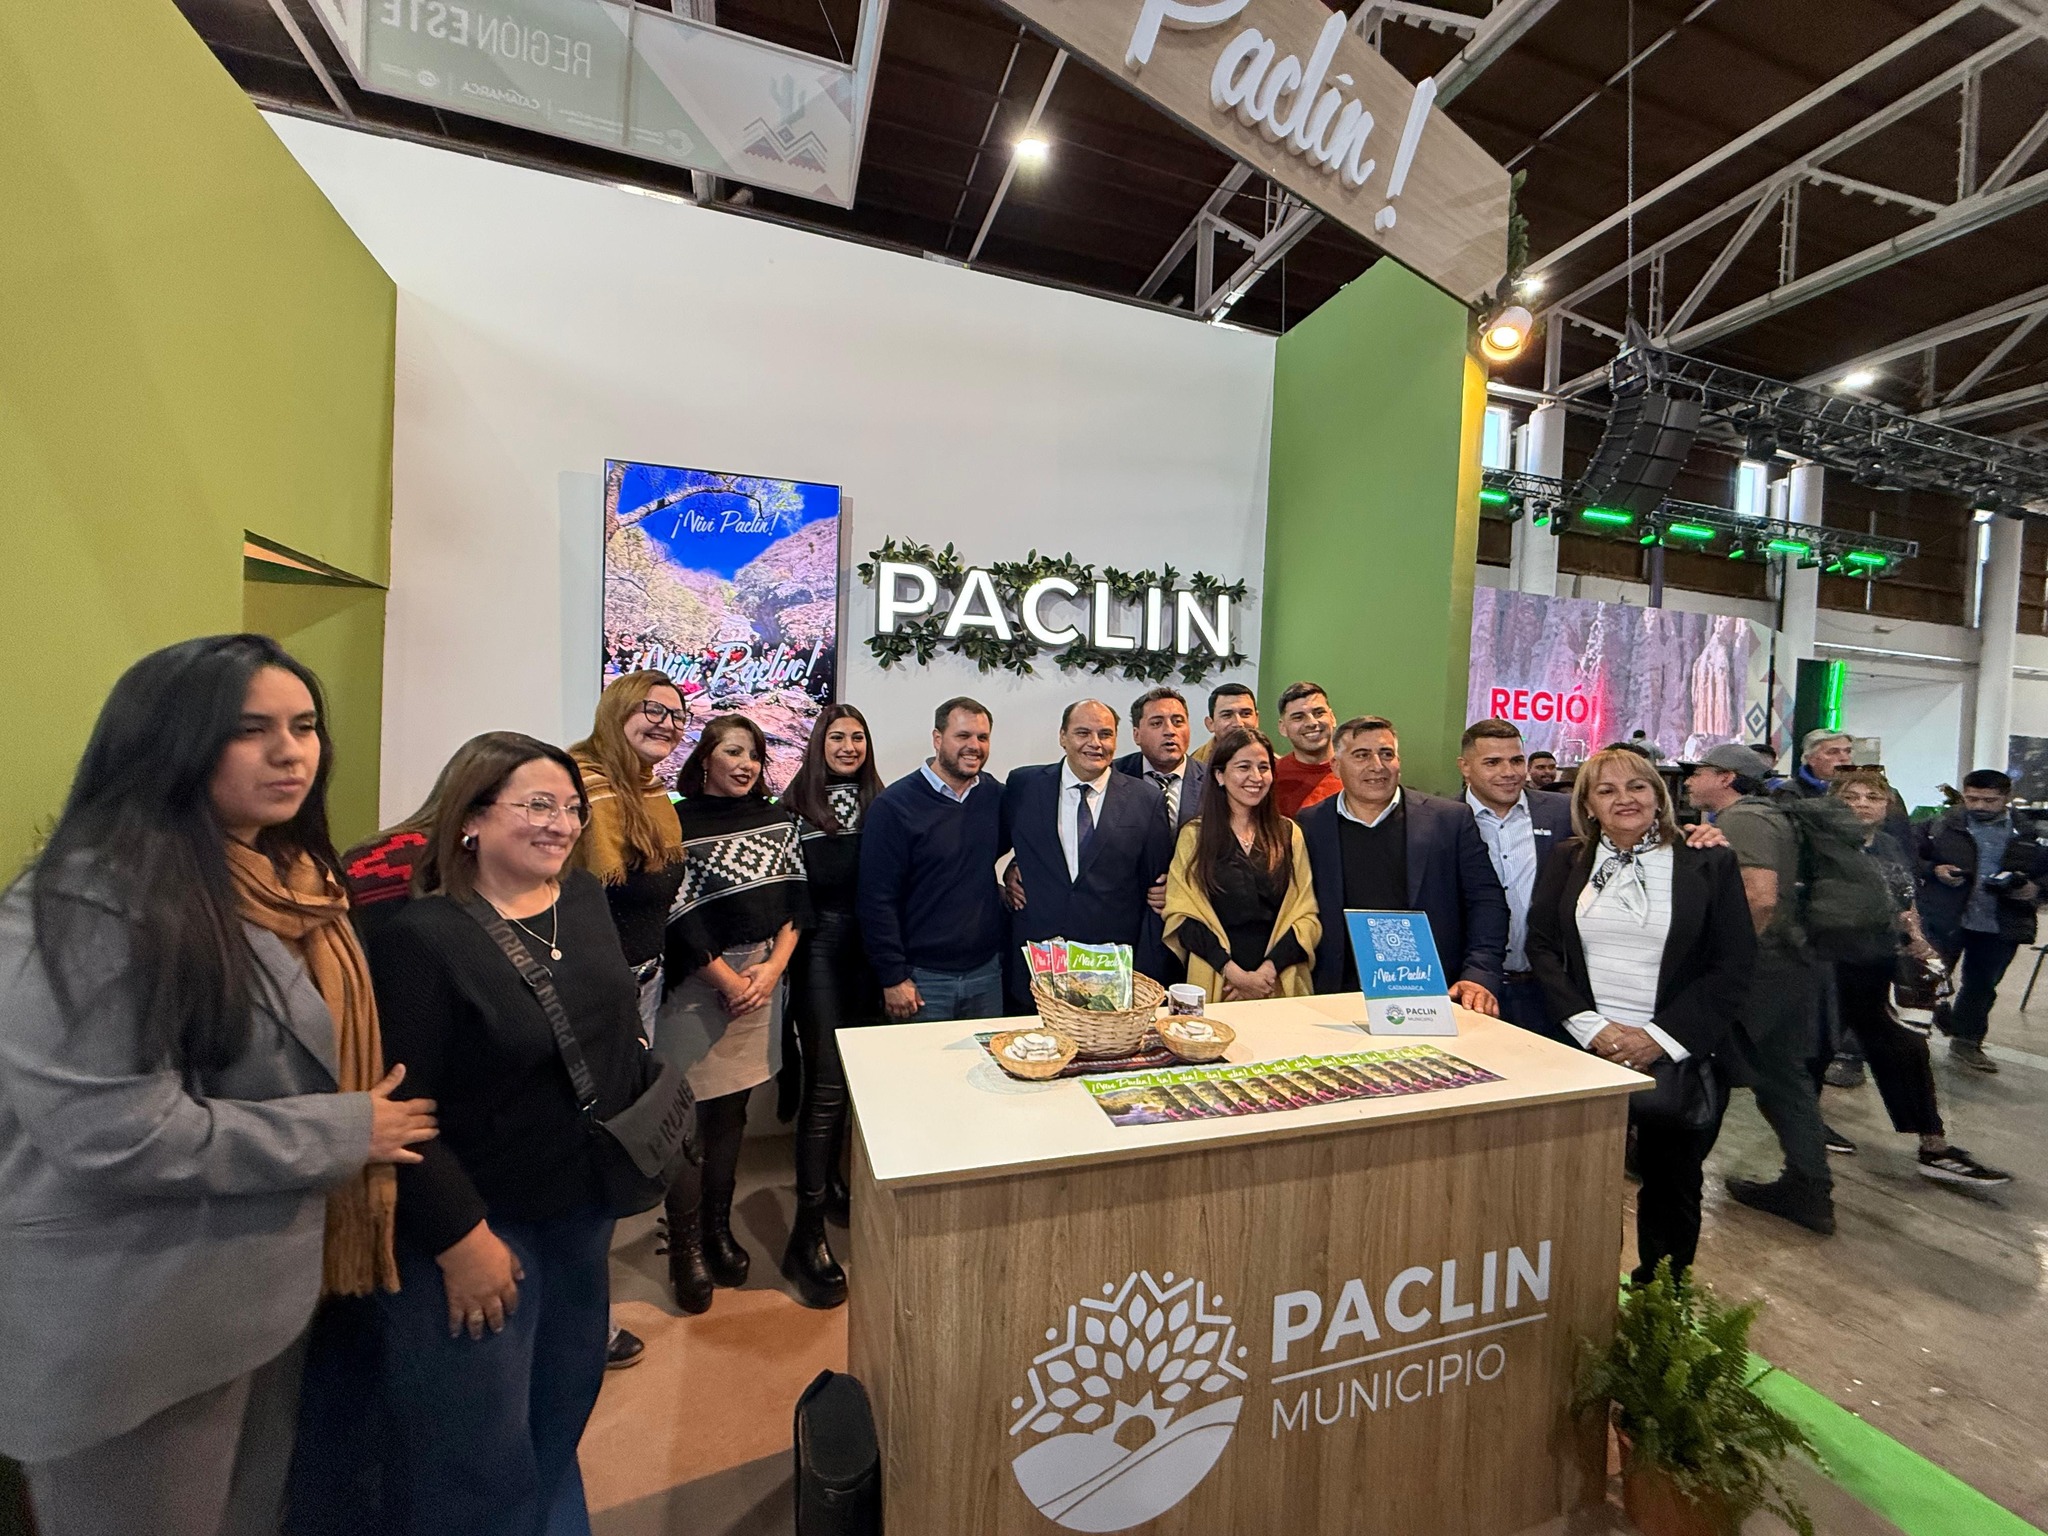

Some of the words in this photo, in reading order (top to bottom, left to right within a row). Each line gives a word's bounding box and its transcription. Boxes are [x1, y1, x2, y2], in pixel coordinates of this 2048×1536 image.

[876, 560, 1233, 660] PACLIN
[1405, 1007, 1437, 1016] PACLIN
[1271, 1240, 1552, 1364] PACLIN
[1271, 1343, 1507, 1439] MUNICIPIO
